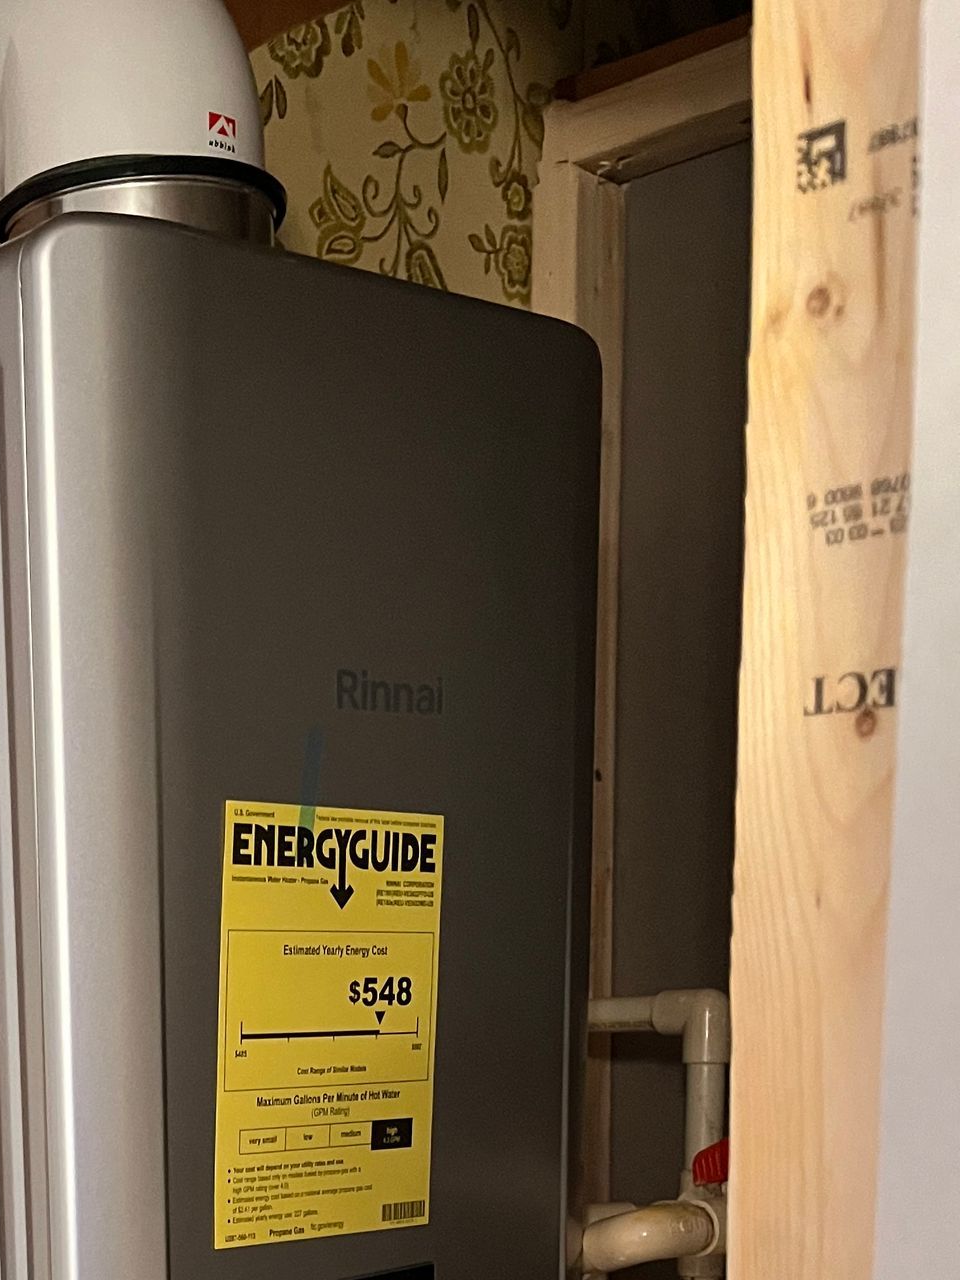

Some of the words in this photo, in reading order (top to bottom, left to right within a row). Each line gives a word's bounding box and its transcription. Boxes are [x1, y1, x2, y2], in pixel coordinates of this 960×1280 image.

[337, 669, 444, 714] Rinnai
[232, 822, 437, 873] ENERGYGUIDE
[284, 944, 320, 955] Estimated
[322, 944, 344, 958] Yearly
[346, 945, 370, 958] Energy
[372, 945, 388, 955] Cost
[349, 976, 412, 1006] $548
[257, 1097, 291, 1107] Maximum
[294, 1095, 320, 1105] Gallons
[323, 1094, 334, 1103] Per
[336, 1092, 359, 1102] Minute
[360, 1091, 367, 1100] of
[369, 1090, 380, 1100] Hot
[381, 1090, 400, 1099] Water
[311, 1108, 329, 1118] (GPM
[330, 1107, 350, 1117] Rating)
[249, 1138, 261, 1146] very
[262, 1136, 277, 1144] small
[269, 1228, 292, 1237] Propane
